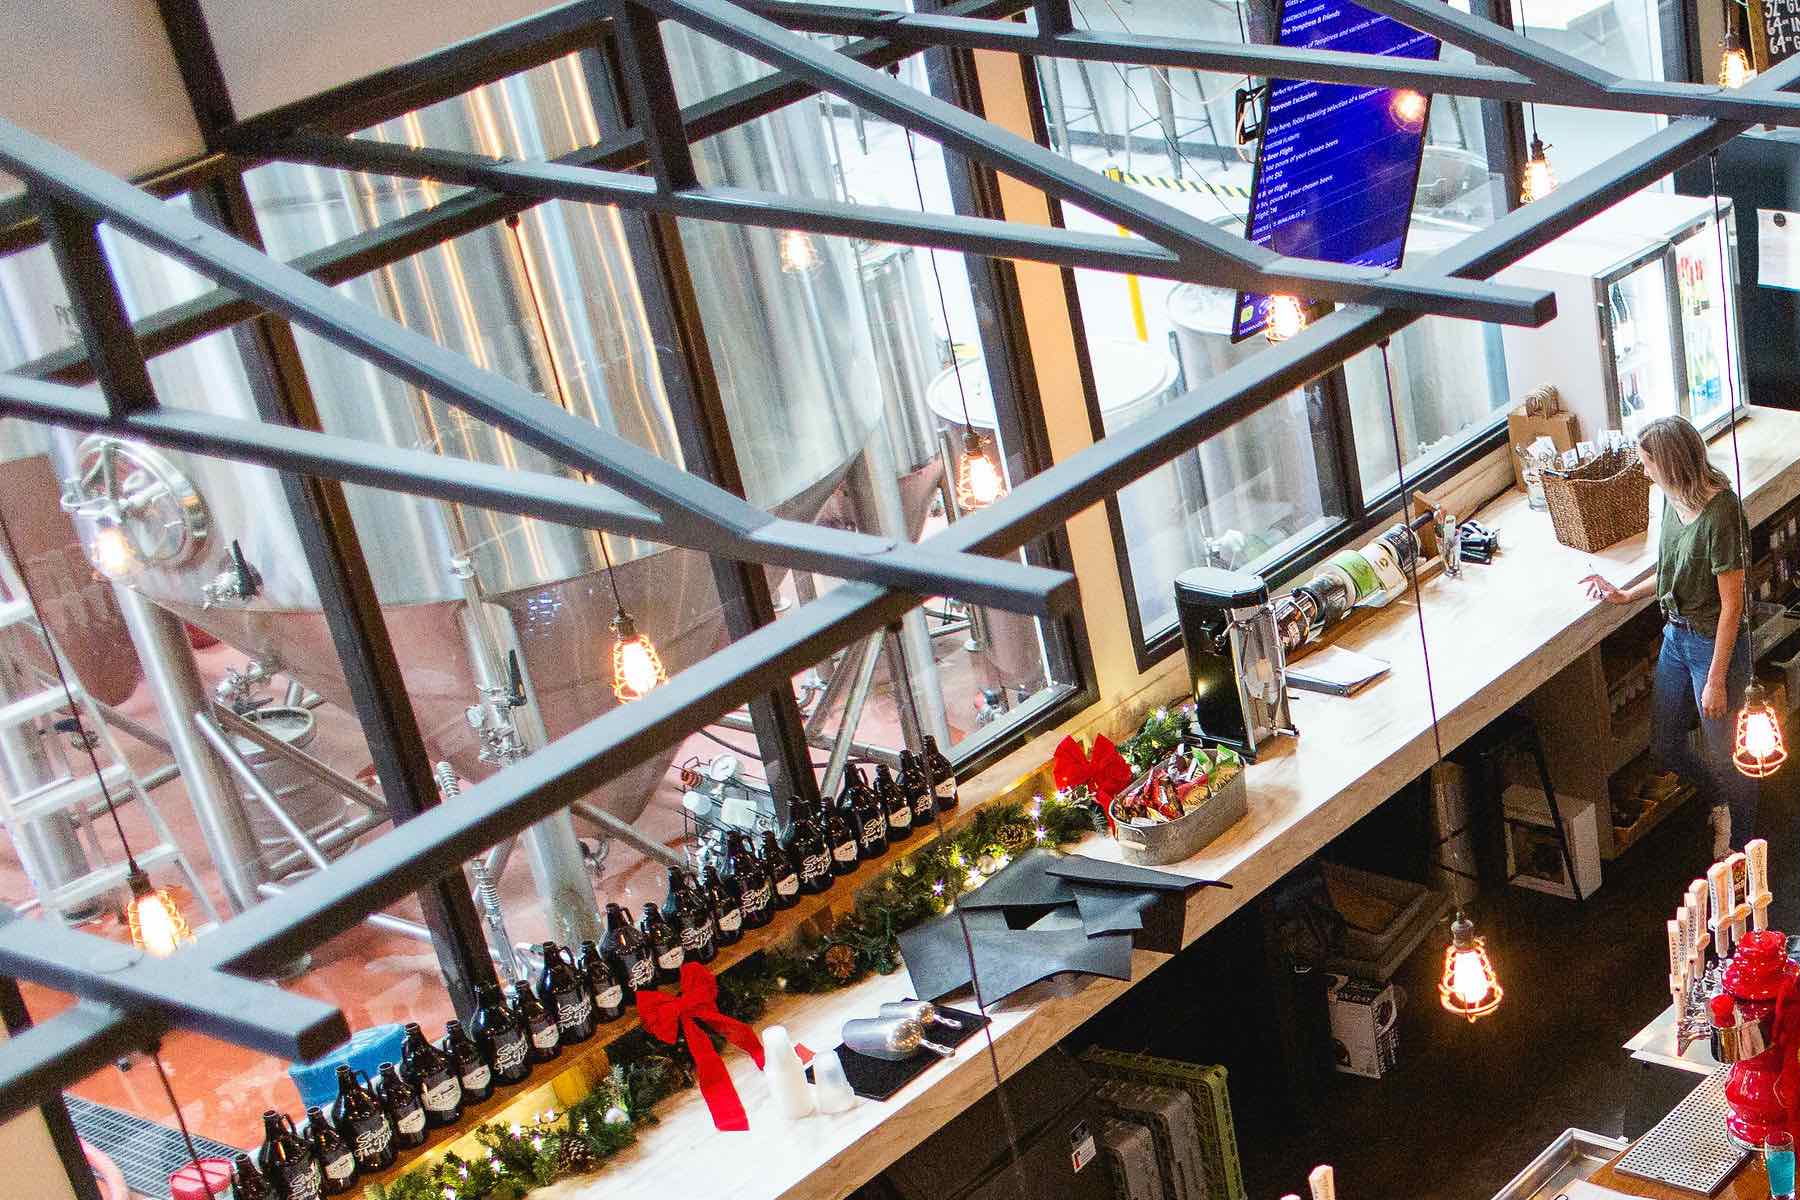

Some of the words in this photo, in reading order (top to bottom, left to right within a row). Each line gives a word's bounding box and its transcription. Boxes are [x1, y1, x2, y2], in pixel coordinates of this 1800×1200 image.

[1291, 18, 1317, 34] Temptress
[1322, 10, 1341, 22] Friends
[1270, 99, 1292, 113] Taproom
[1292, 91, 1318, 105] Exclusives
